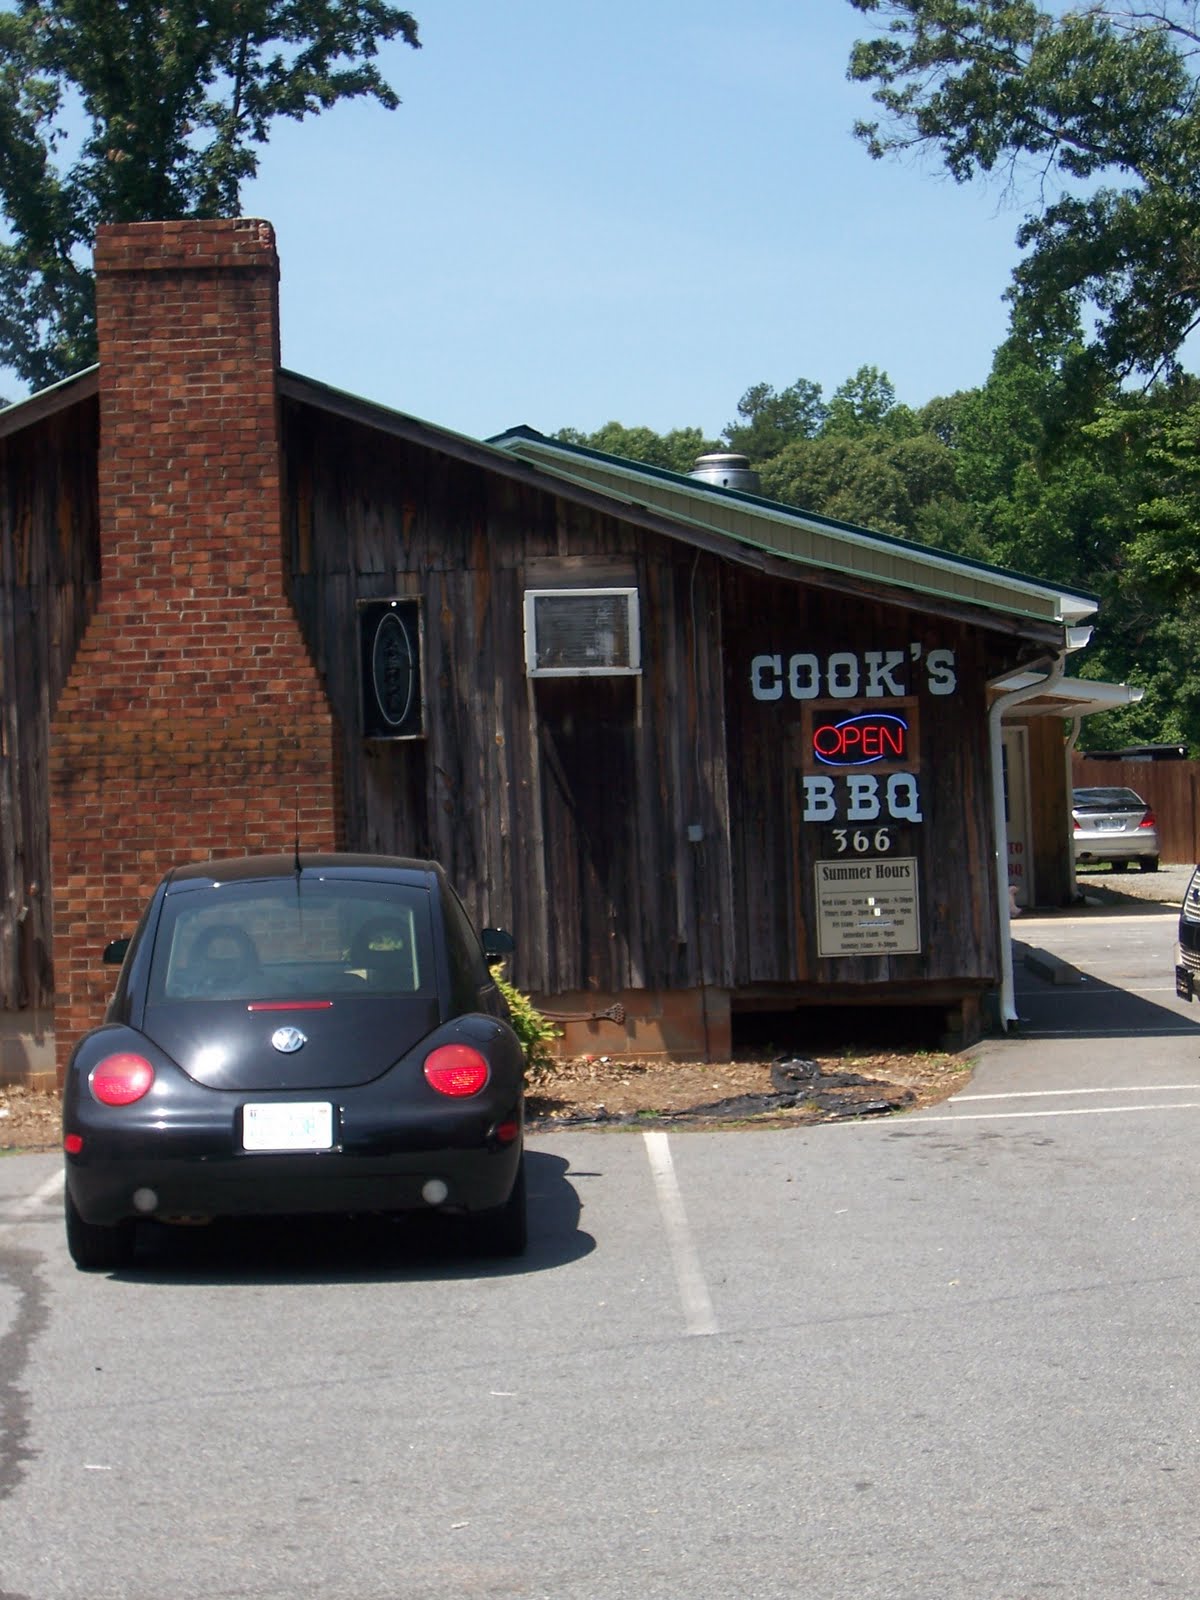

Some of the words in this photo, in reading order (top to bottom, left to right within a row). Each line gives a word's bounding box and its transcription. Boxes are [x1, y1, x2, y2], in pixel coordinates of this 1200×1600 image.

[750, 642, 957, 700] COOK'S
[813, 725, 903, 755] OPEN
[803, 773, 922, 823] BBQ
[831, 828, 891, 852] 366
[823, 866, 872, 881] Summer
[876, 864, 910, 879] Hours
